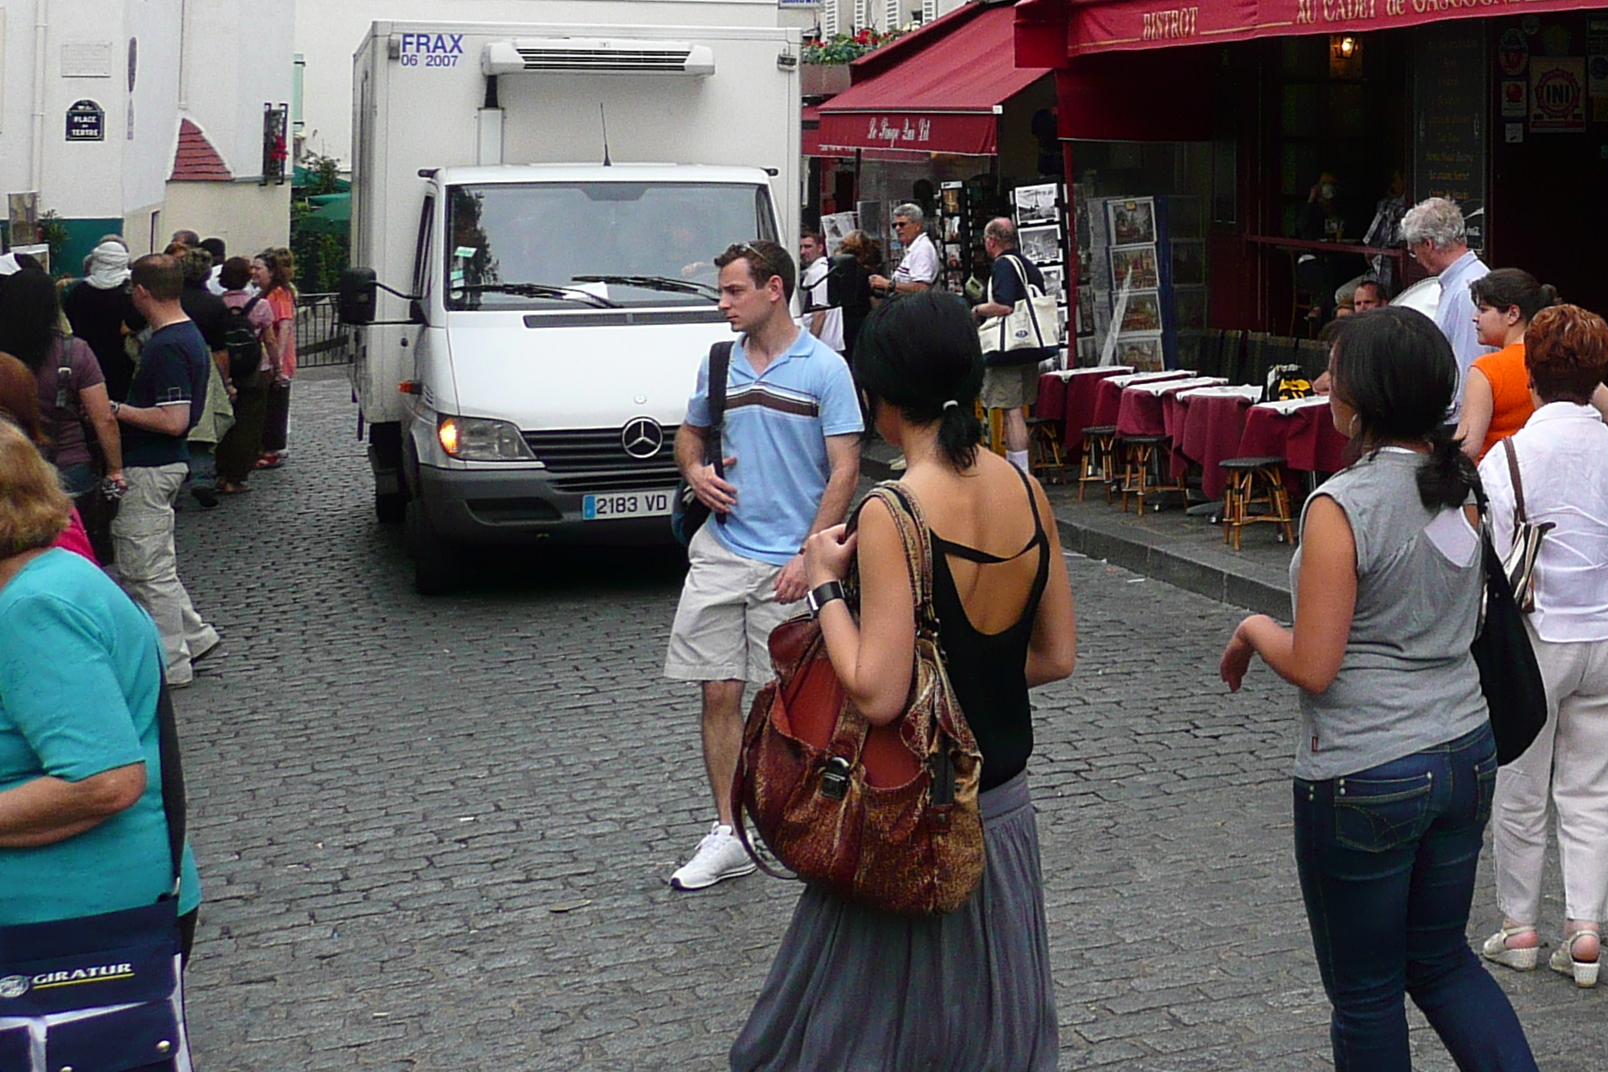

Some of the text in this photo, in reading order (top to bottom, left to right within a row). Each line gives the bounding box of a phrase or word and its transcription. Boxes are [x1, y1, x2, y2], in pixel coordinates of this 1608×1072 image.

[1143, 6, 1198, 40] BISTROT
[402, 33, 464, 54] FRAX
[401, 54, 458, 67] 06 2007
[597, 494, 667, 514] 2183 VD
[32, 963, 132, 984] GIRATUR
